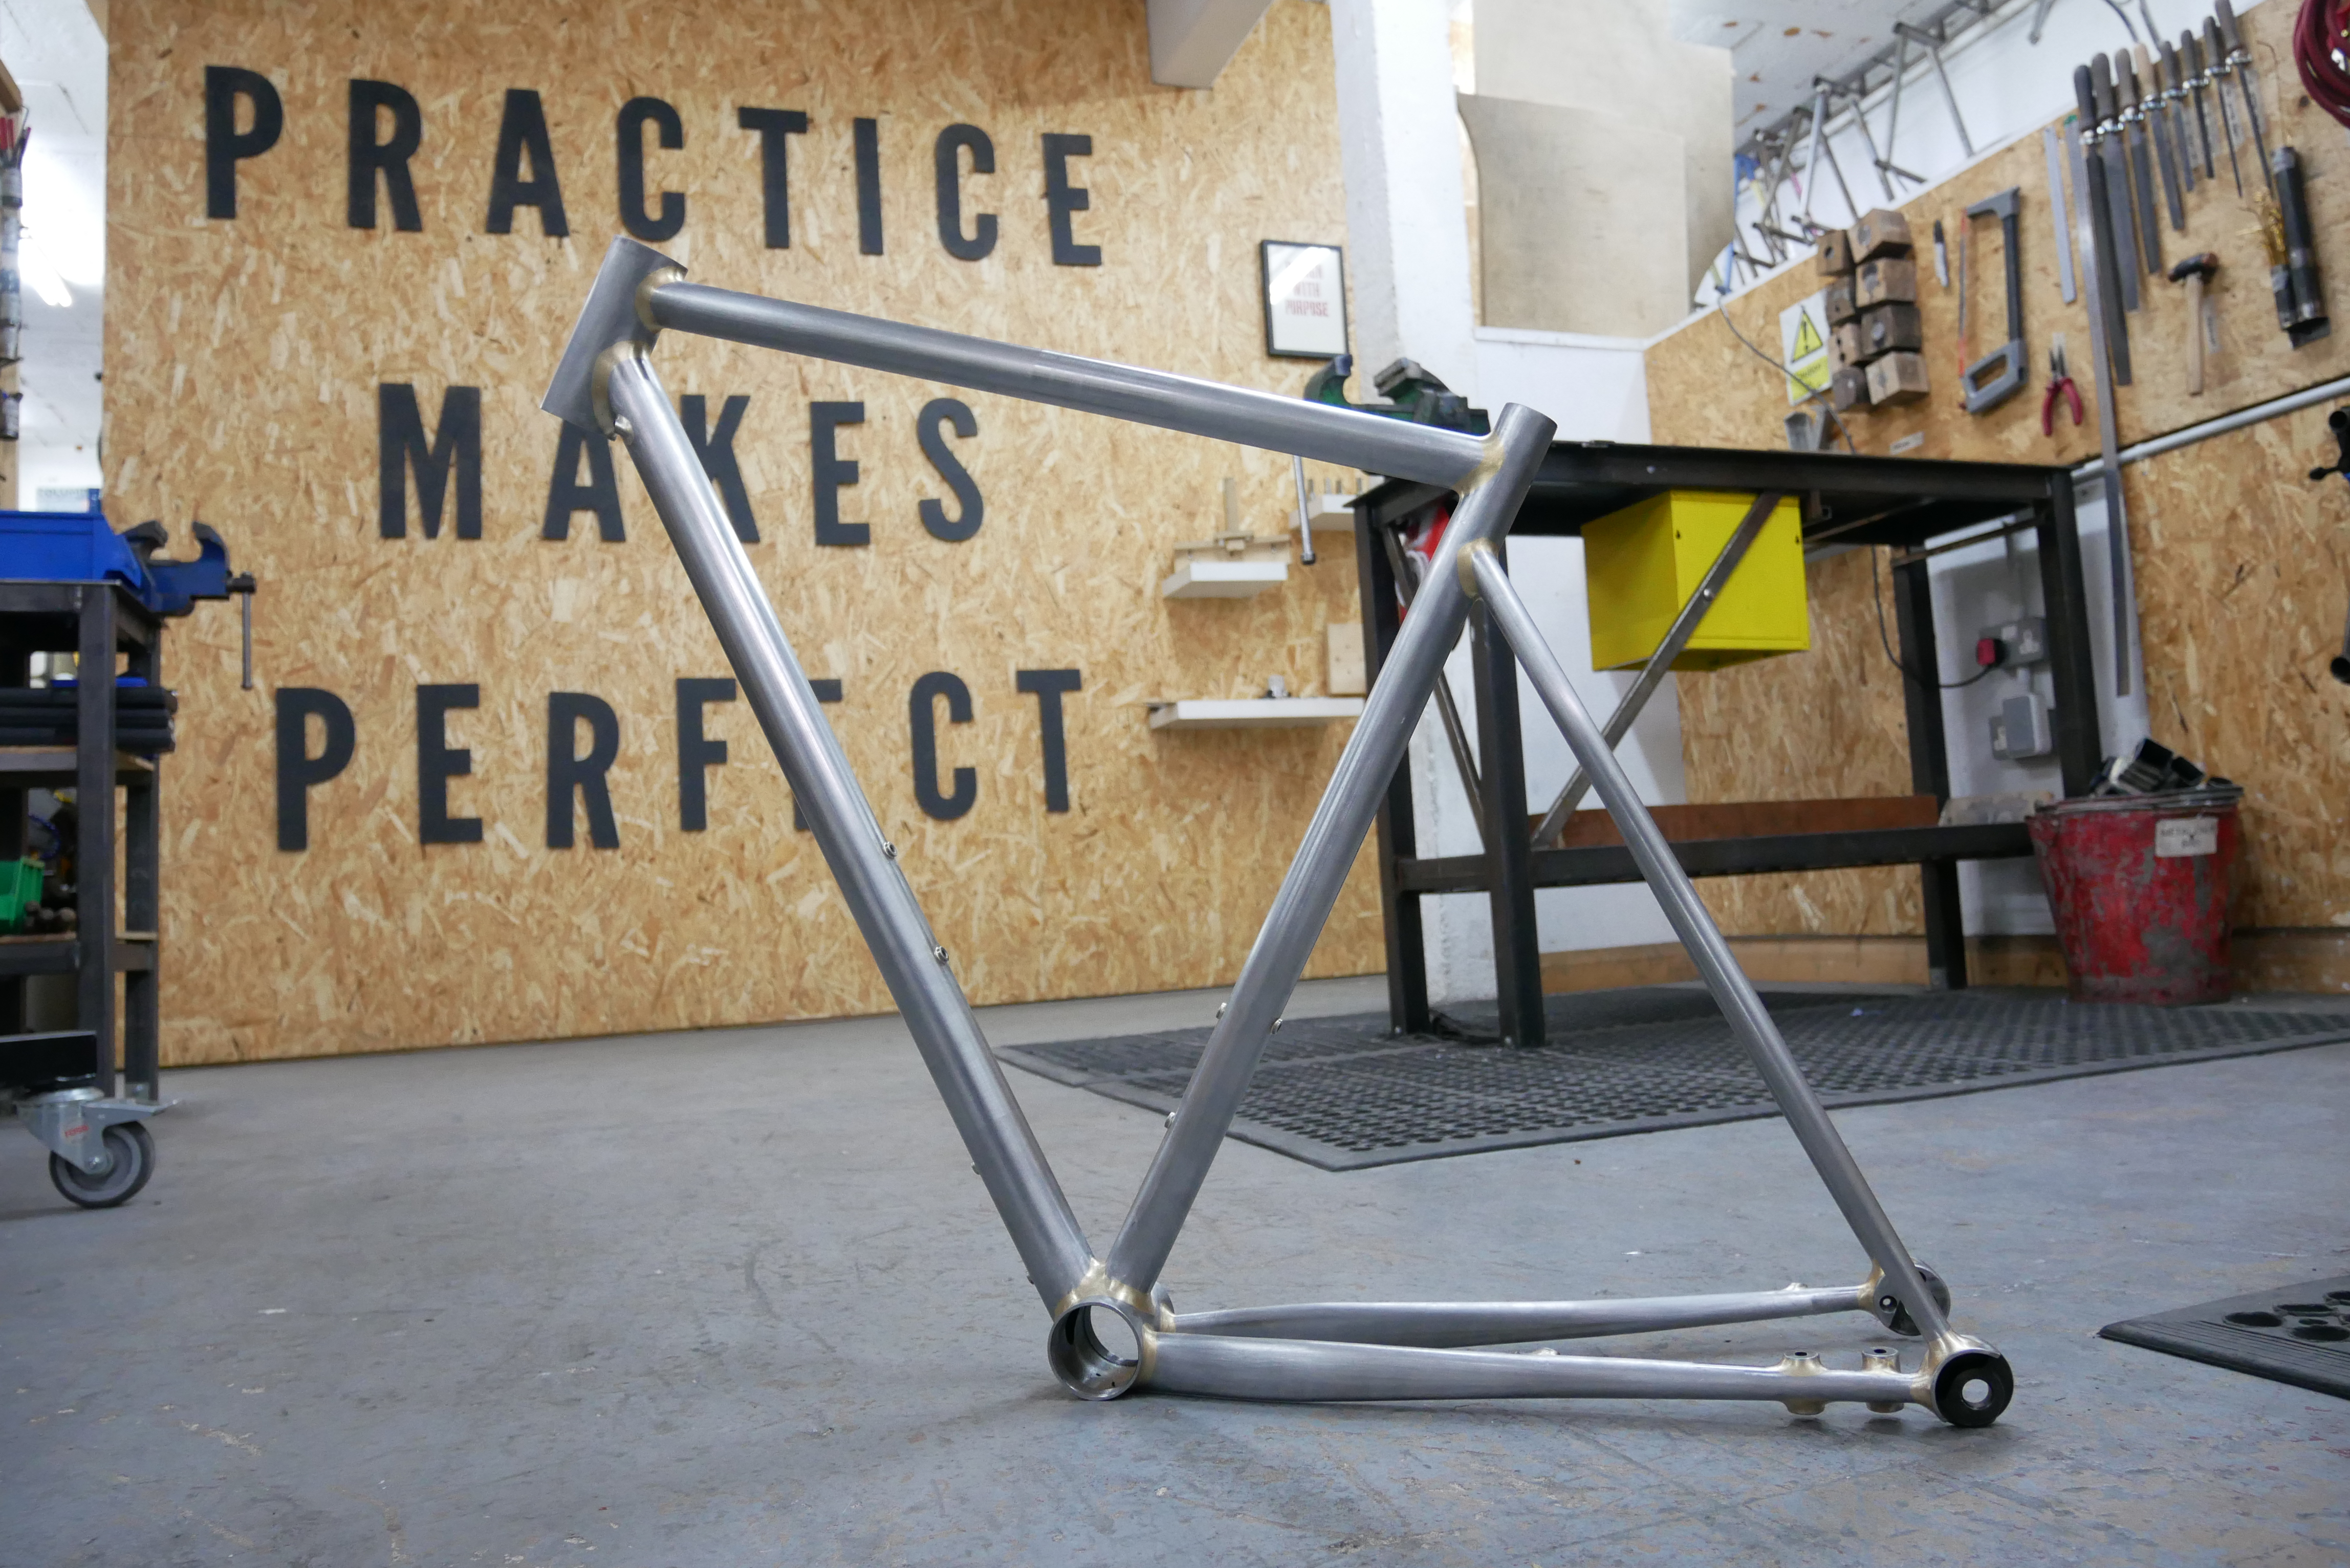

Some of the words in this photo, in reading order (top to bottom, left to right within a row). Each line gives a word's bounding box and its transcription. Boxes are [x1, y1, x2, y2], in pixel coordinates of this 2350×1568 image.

[205, 65, 1103, 266] PRACTICE
[1286, 300, 1329, 317] PURPOSE
[379, 382, 985, 546] MAKES
